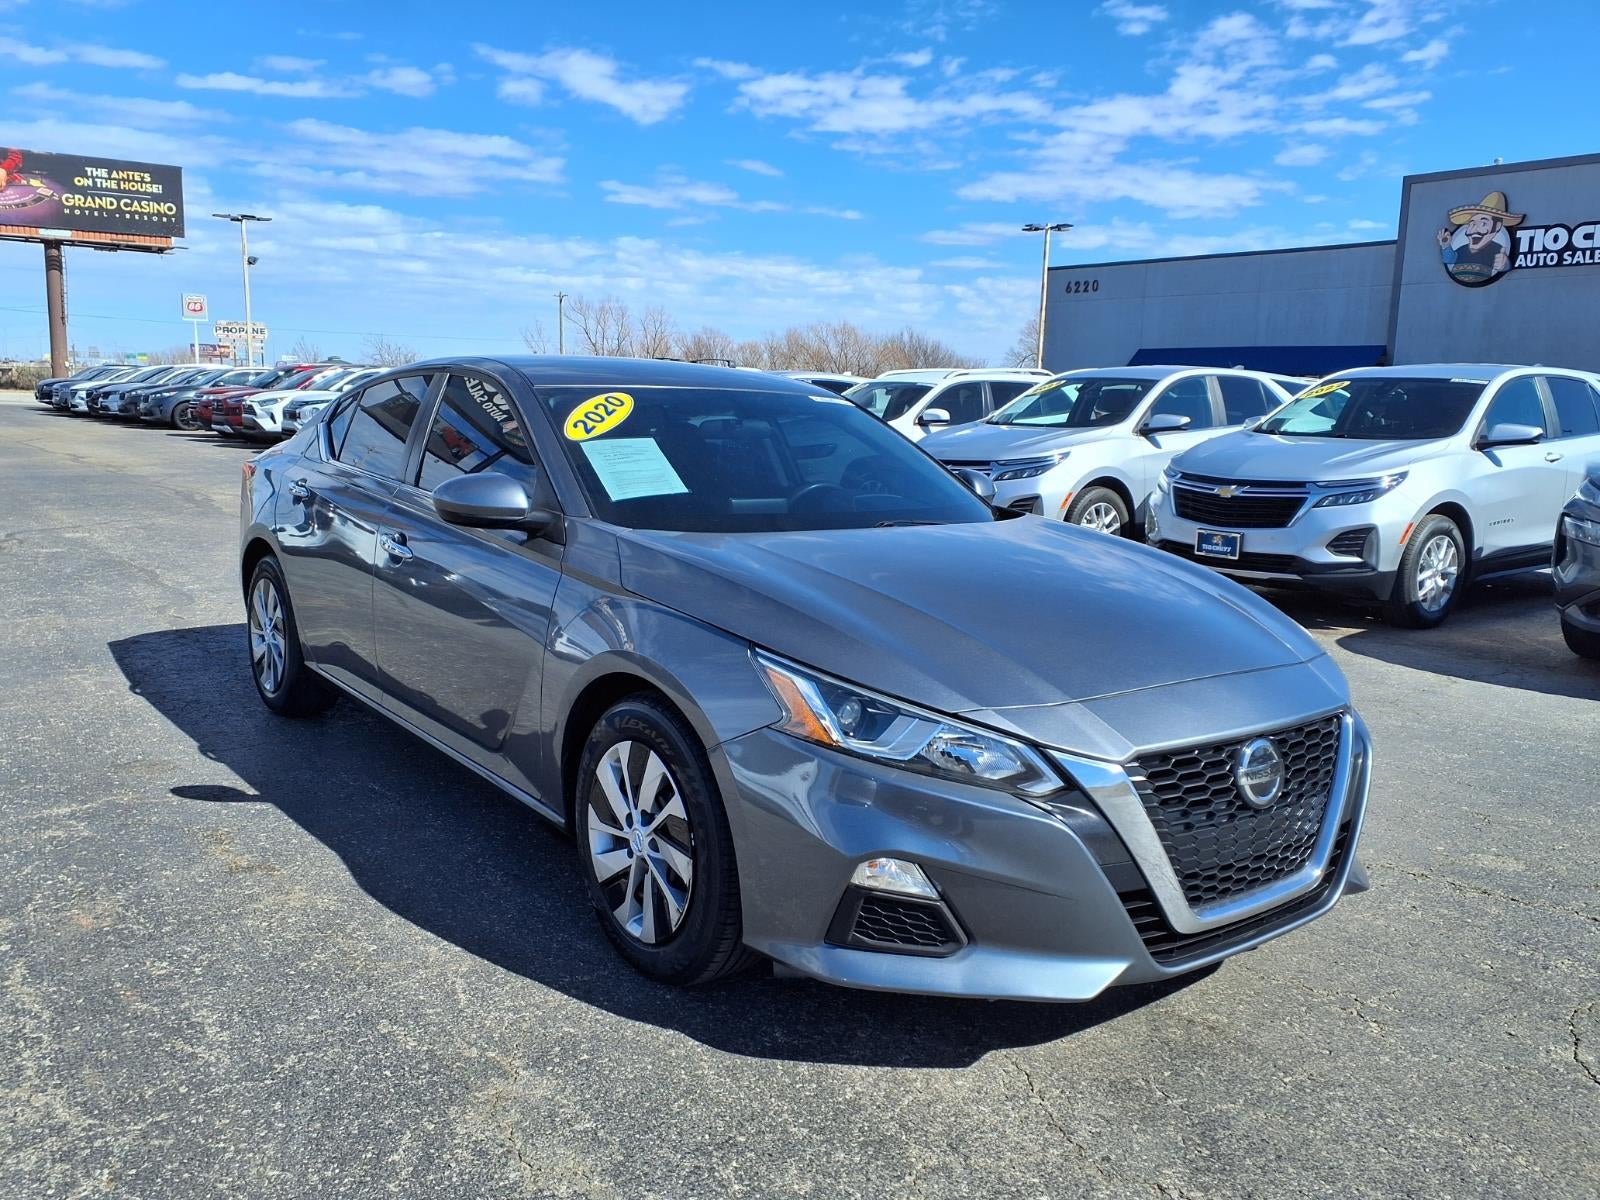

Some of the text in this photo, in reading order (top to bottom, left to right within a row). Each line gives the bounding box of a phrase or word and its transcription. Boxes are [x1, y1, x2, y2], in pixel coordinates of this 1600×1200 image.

[85, 167, 151, 181] THE ANTE'S
[74, 176, 163, 194] ON THE HOUSE!
[61, 193, 177, 215] GRAND CASINO
[64, 208, 176, 223] HOTEL RESORT
[1516, 227, 1569, 252] TIO
[1514, 252, 1559, 268] AUTO
[1065, 279, 1099, 294] 6220
[572, 395, 625, 435] 2020
